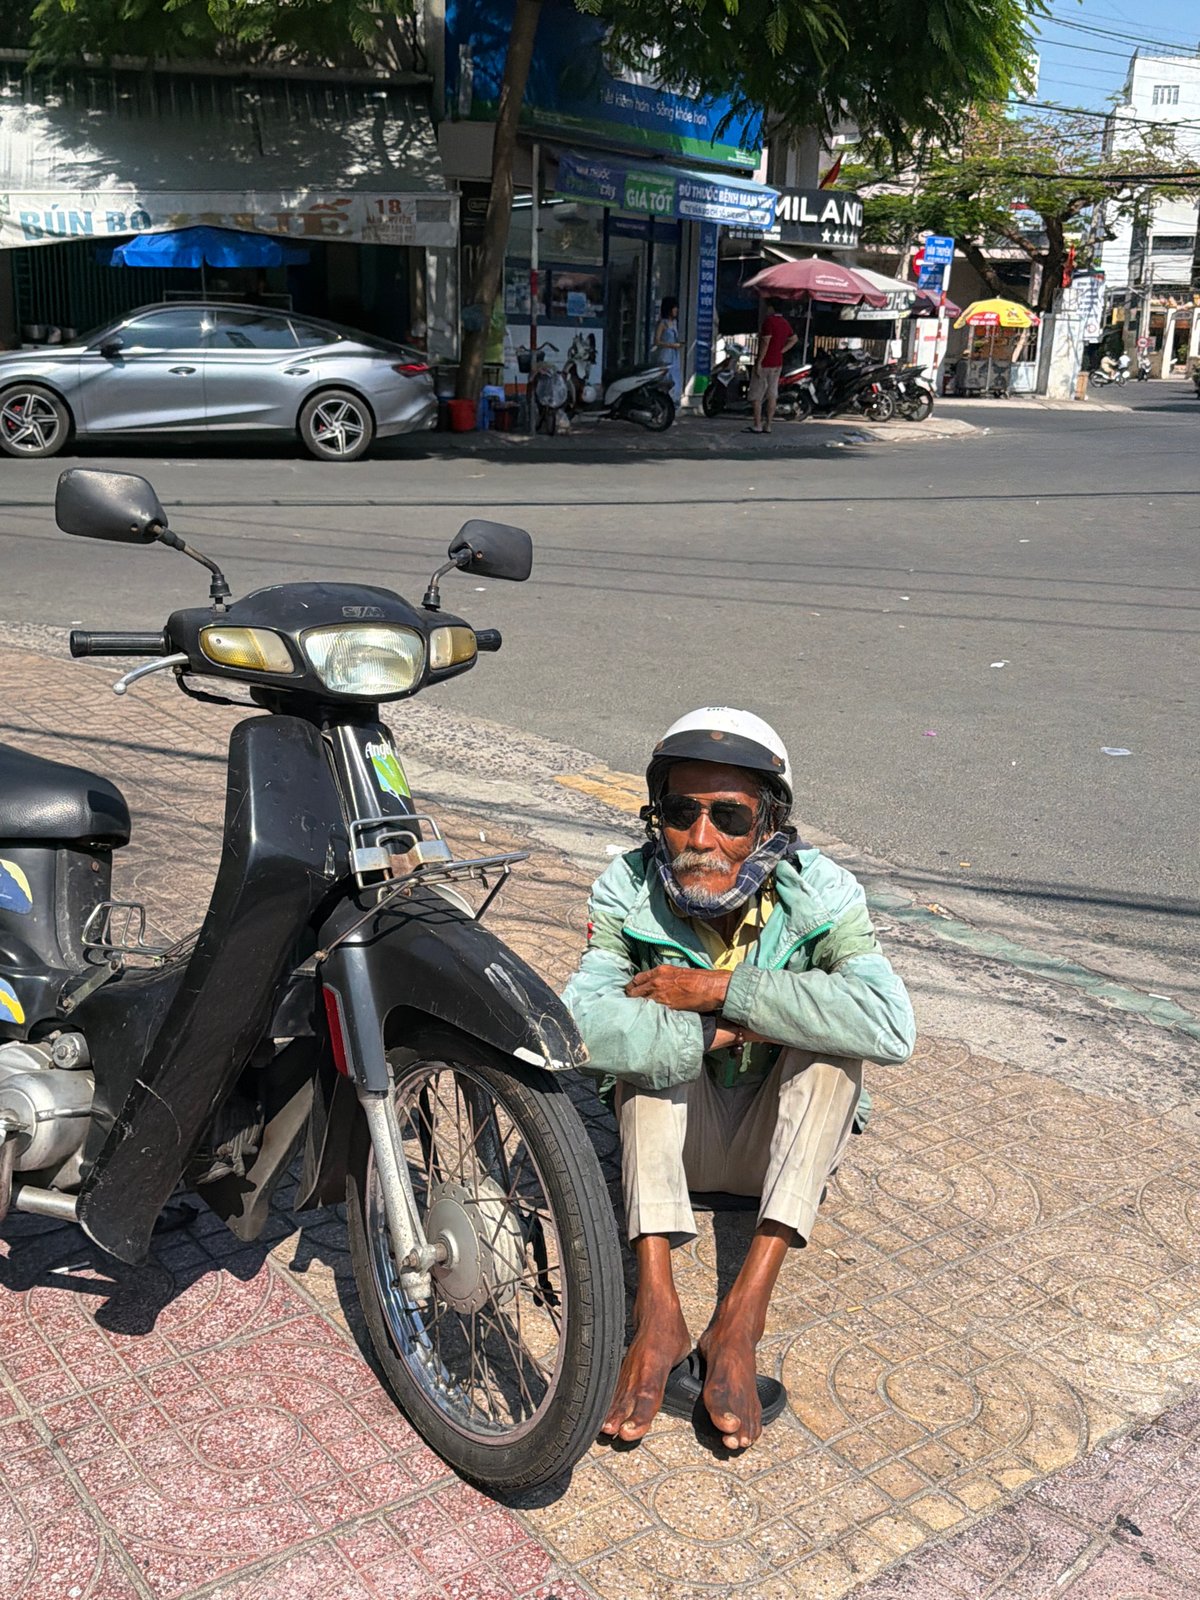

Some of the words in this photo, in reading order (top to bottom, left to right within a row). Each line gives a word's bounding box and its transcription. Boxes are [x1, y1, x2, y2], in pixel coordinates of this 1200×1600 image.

[375, 199, 402, 215] 18
[626, 187, 648, 209] GIÁ
[650, 187, 673, 211] TỐT
[19, 203, 95, 241] BÚN
[105, 202, 151, 233] BÒ
[365, 740, 391, 760] Angel
